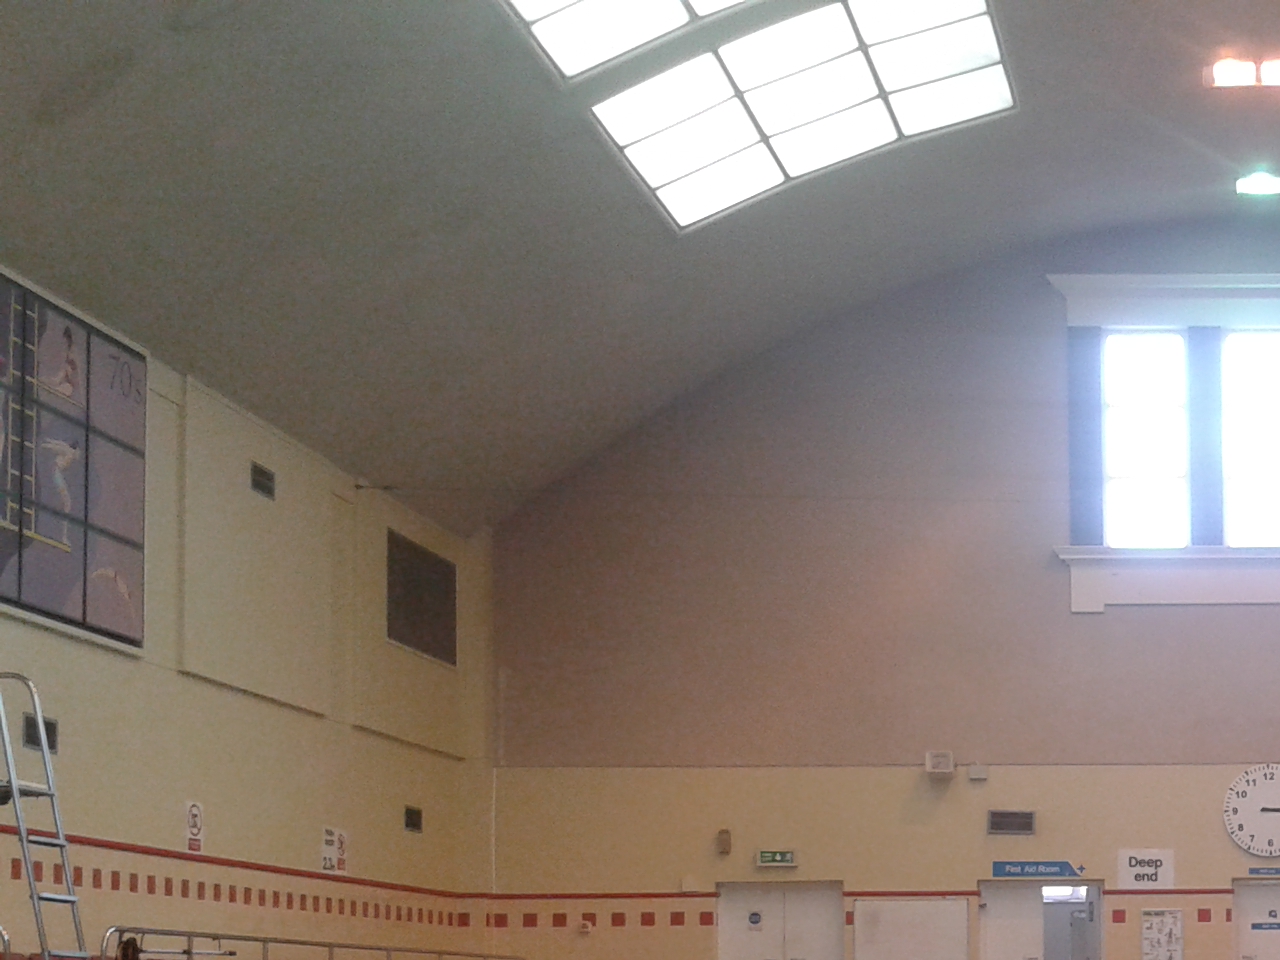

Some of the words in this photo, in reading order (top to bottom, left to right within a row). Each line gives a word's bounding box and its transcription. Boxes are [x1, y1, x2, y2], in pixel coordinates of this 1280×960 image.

[108, 354, 142, 405] 70s
[1263, 772, 1275, 781] 12
[1245, 778, 1257, 787] 11
[1235, 790, 1248, 799] 10
[1232, 807, 1239, 816] 9
[1237, 823, 1244, 832] 8
[1249, 834, 1255, 843] 7
[1267, 838, 1274, 847] 6
[1128, 856, 1163, 870] Deep
[1005, 864, 1021, 874] First
[1024, 864, 1037, 873] Aid
[1038, 864, 1060, 873] Room
[1134, 870, 1159, 882] end
